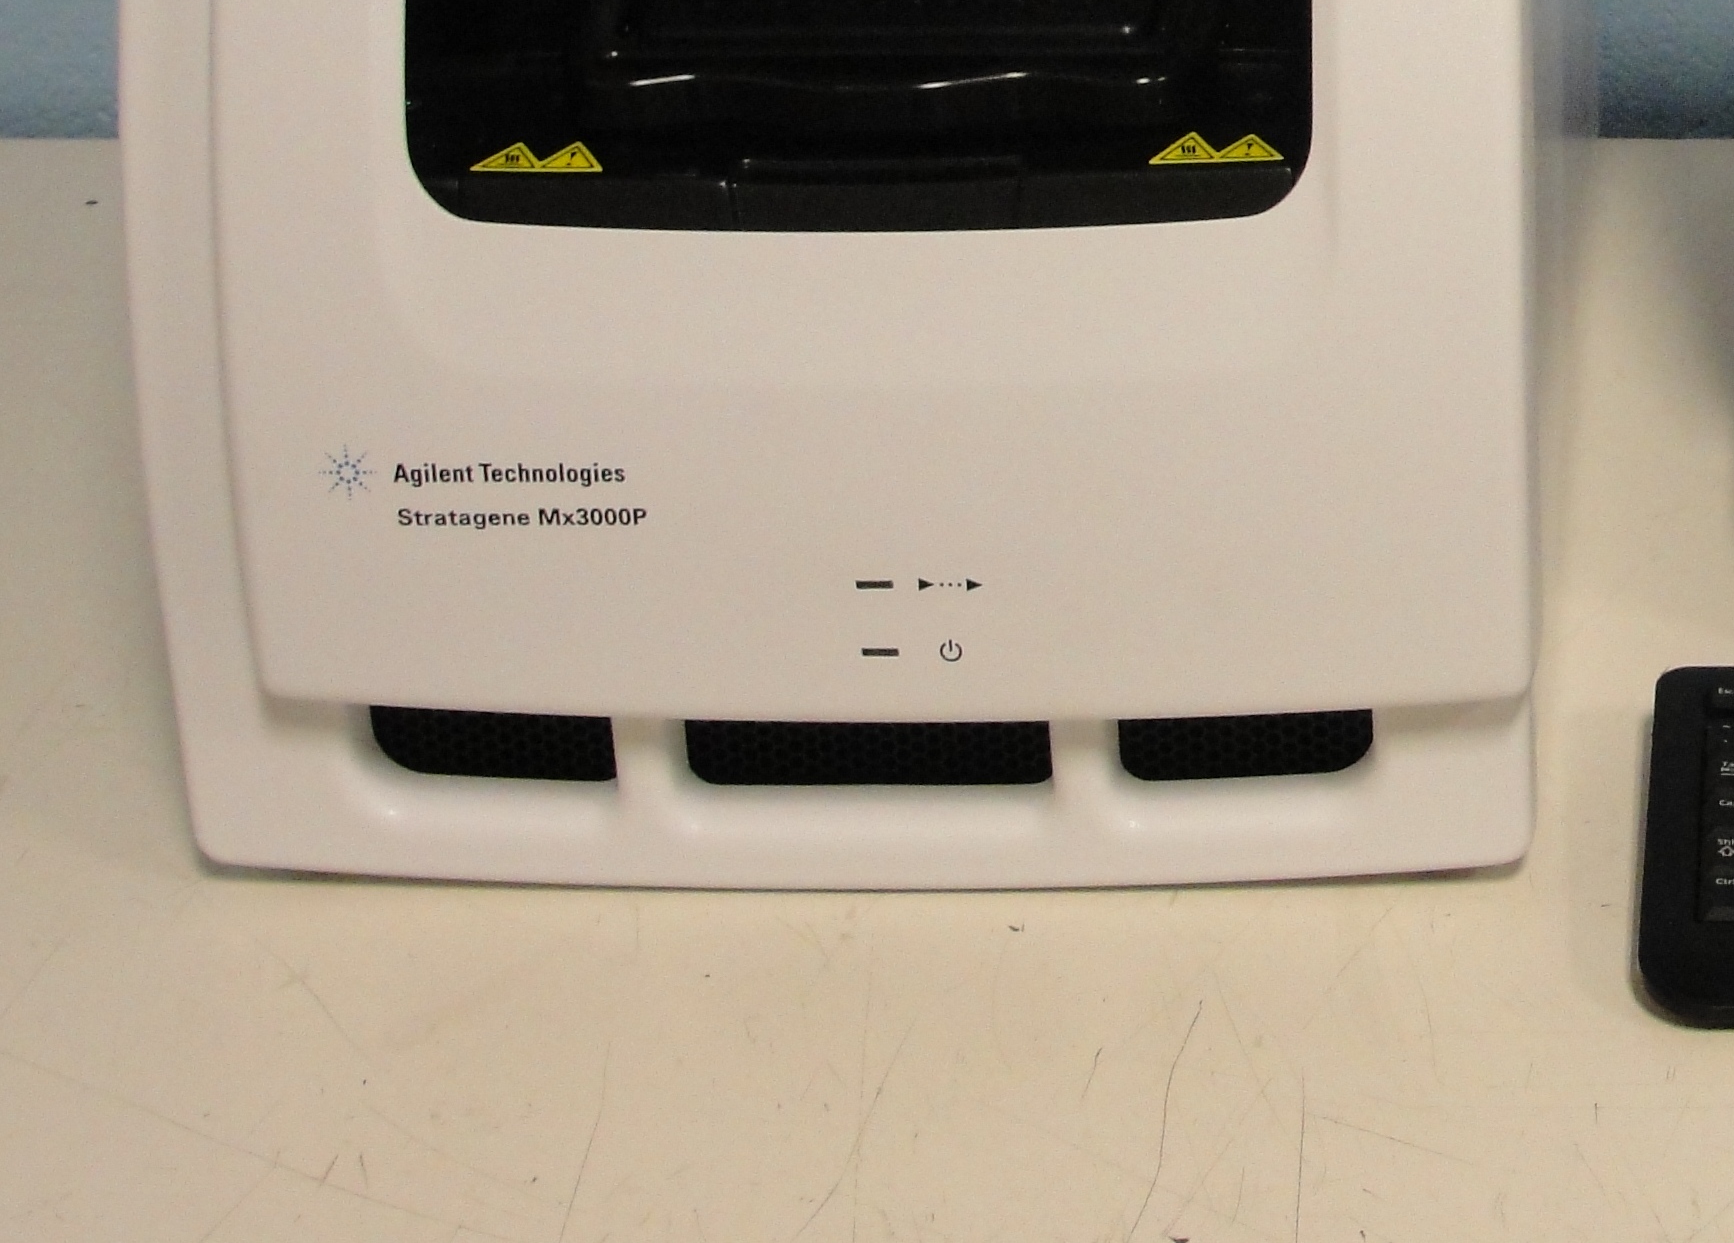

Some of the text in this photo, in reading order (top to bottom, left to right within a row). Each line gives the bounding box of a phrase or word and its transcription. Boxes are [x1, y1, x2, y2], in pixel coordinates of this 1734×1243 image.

[394, 463, 624, 487] Agilent Technologies
[398, 509, 646, 529] Stratagene Mx3000P
